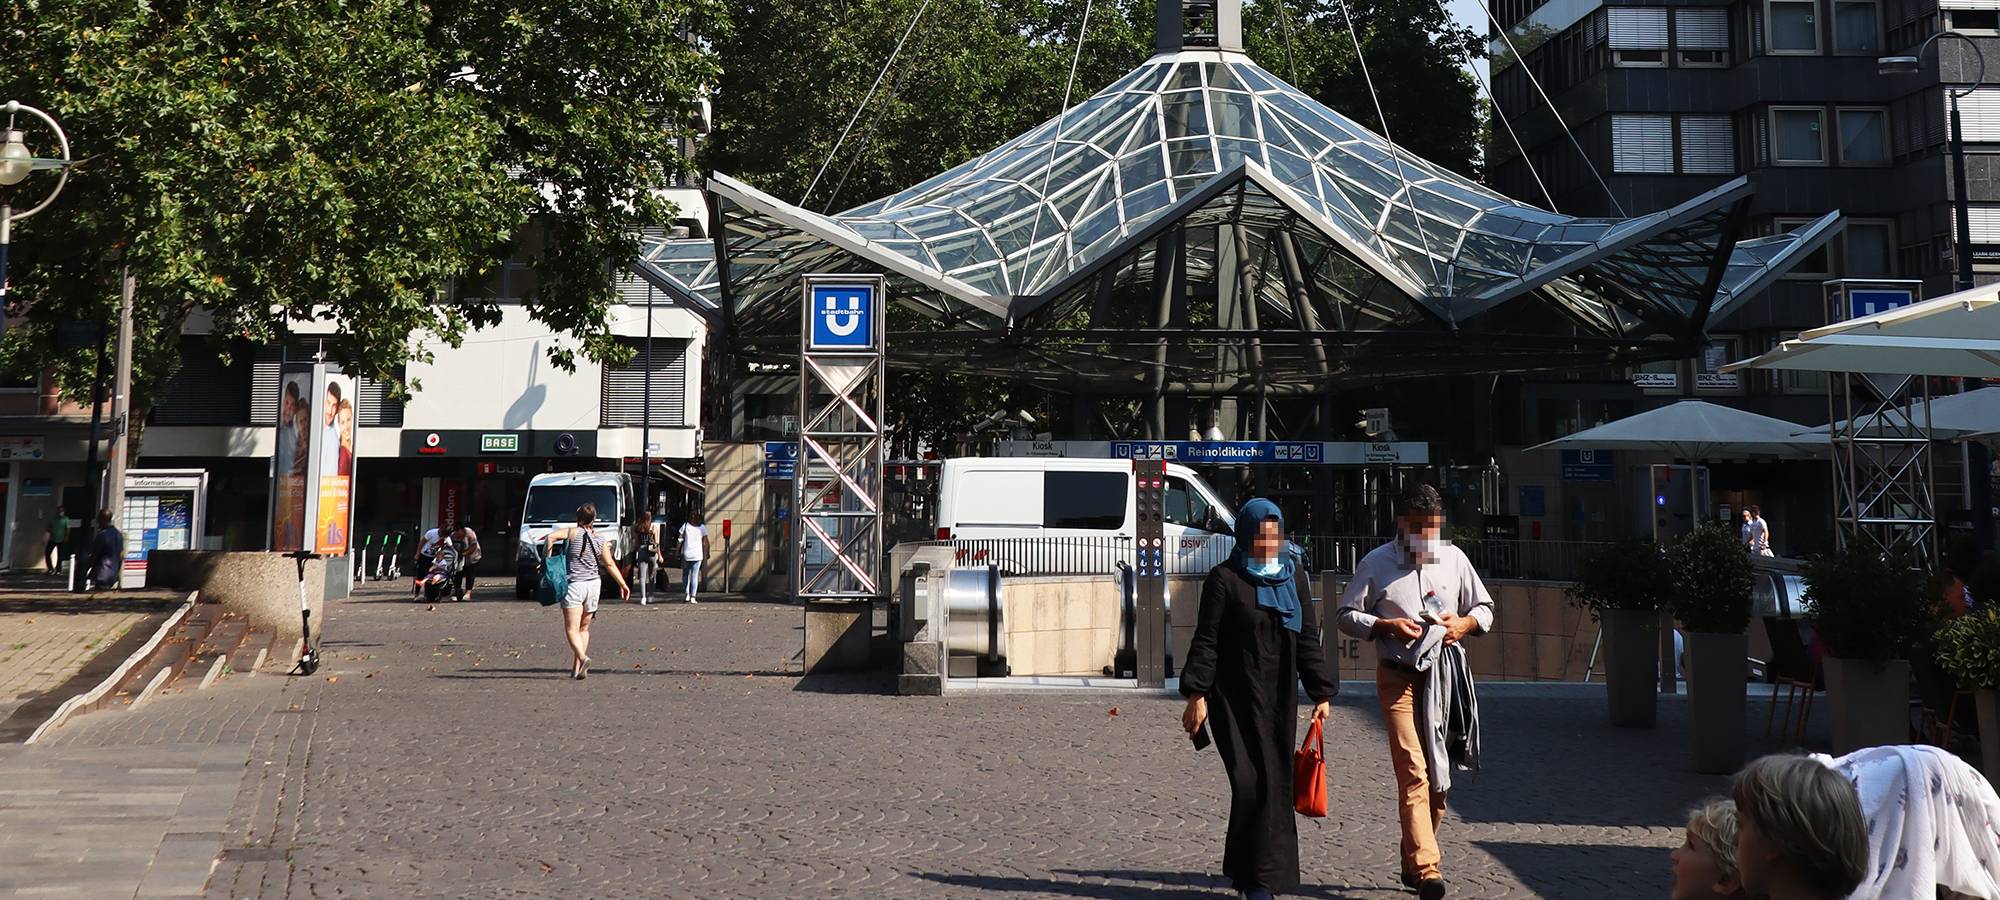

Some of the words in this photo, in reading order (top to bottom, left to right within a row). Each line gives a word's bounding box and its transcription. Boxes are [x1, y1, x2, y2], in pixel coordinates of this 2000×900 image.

[485, 438, 514, 447] BASE
[1032, 442, 1053, 450] Kiosk
[1188, 446, 1264, 457] Reinoldikirche
[1275, 448, 1288, 456] WC
[446, 488, 456, 532] odafone
[327, 522, 343, 545] ils
[1181, 539, 1209, 548] DSW21
